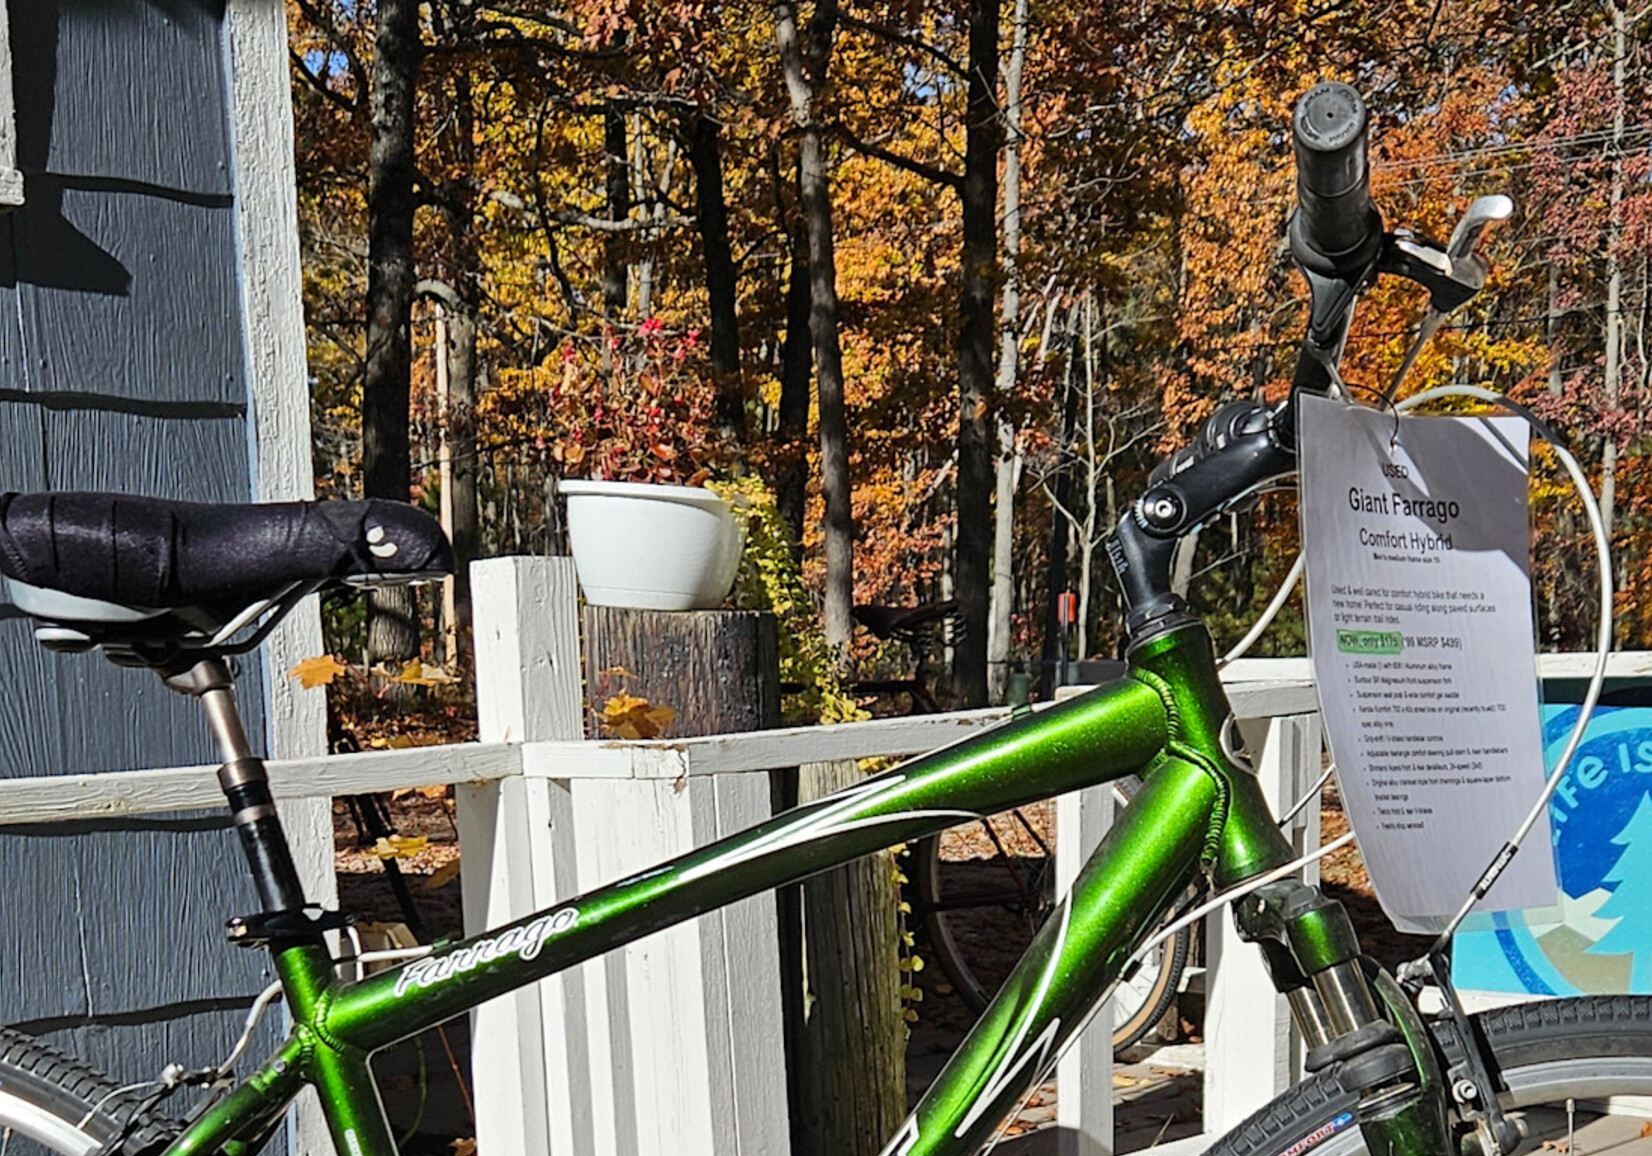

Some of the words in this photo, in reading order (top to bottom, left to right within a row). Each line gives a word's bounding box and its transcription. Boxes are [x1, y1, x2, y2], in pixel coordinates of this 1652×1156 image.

[1382, 463, 1409, 479] USED
[1349, 486, 1389, 515] Giant
[1392, 493, 1460, 524] Farrago
[1360, 527, 1408, 550] Comfort
[1410, 531, 1454, 554] Hybrid
[1417, 637, 1439, 649] MSRP
[394, 906, 580, 998] Farrago
